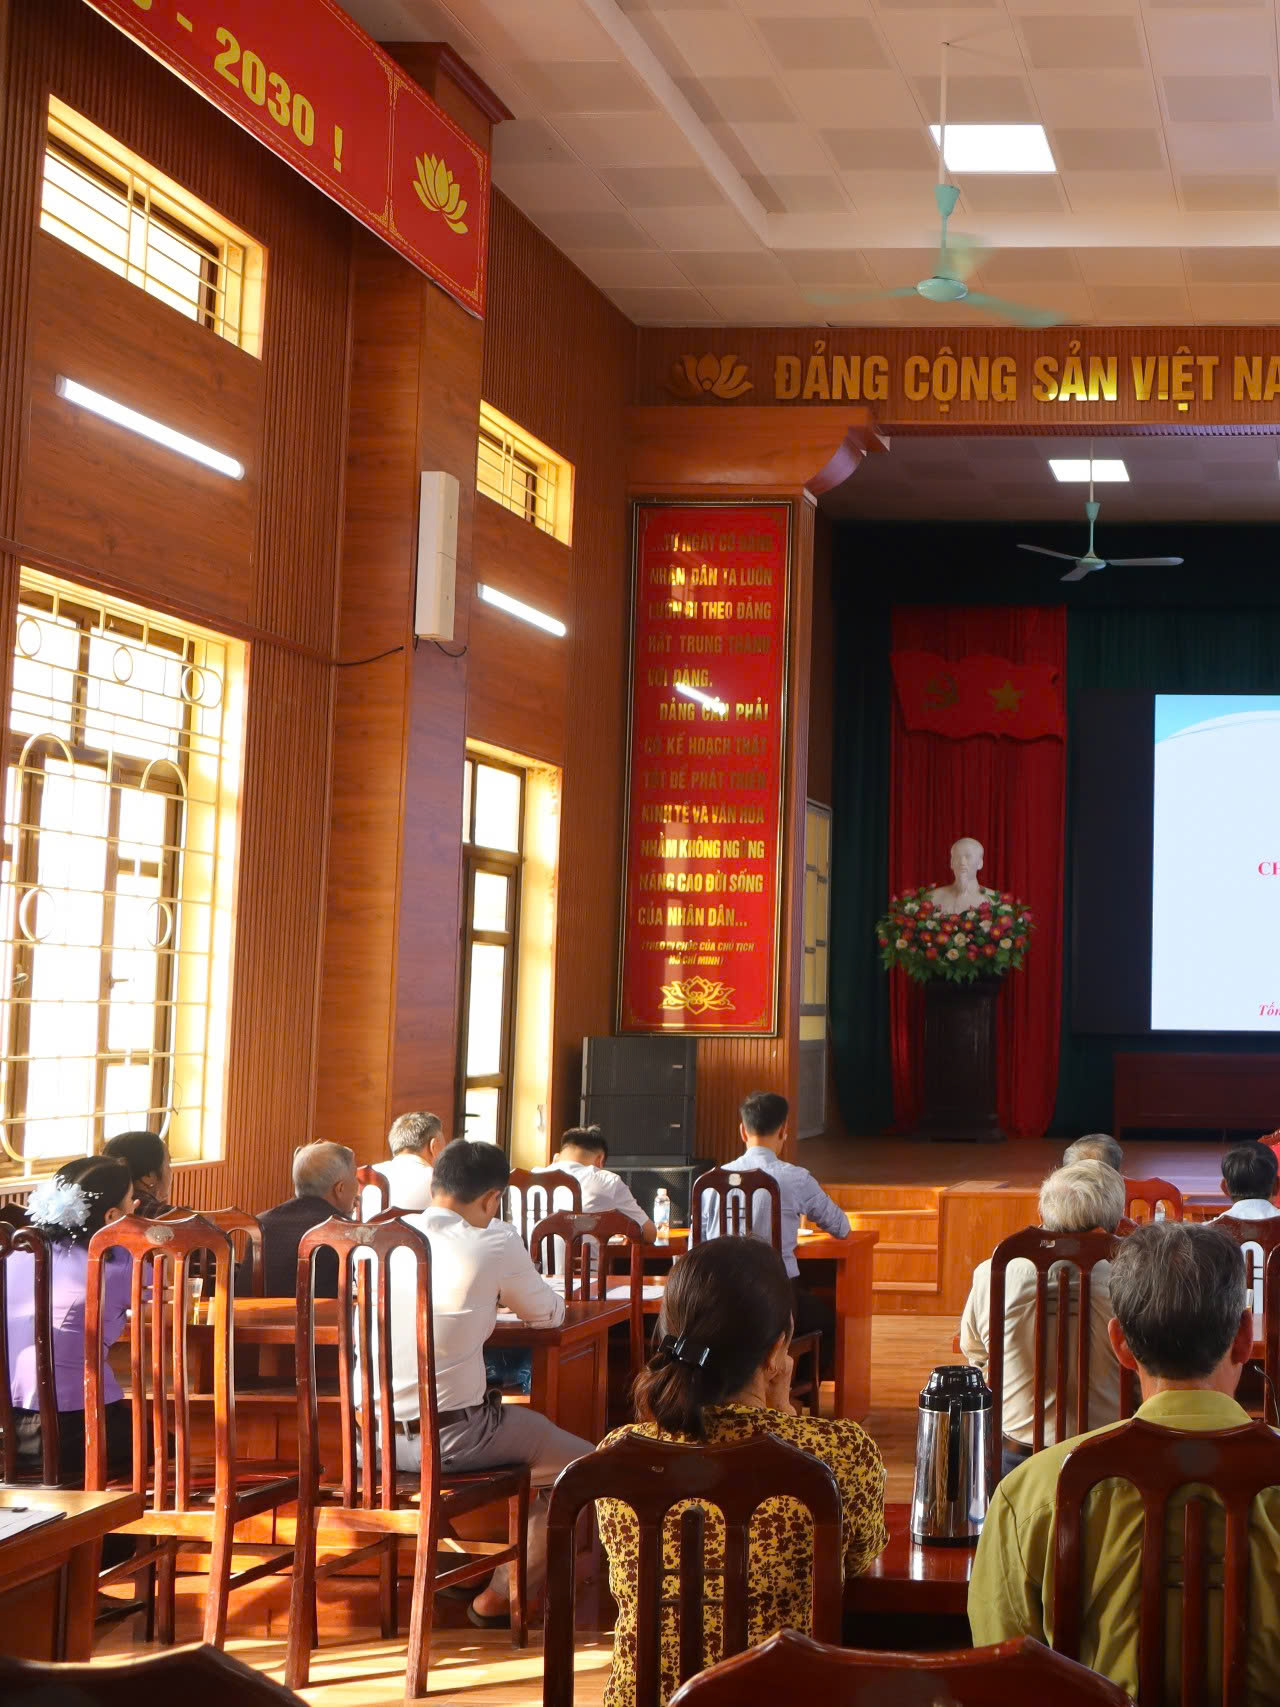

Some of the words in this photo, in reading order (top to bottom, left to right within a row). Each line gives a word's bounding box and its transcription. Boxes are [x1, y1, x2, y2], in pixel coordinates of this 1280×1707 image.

[214, 27, 314, 146] 2030
[776, 340, 889, 399] ĐẢNG
[903, 346, 1017, 412] CỘNG
[1032, 340, 1118, 401] SẢN
[1131, 346, 1220, 411] VIỆT
[722, 568, 737, 586] TA
[701, 601, 733, 620] THEO
[735, 594, 772, 620] ĐẢNG
[679, 634, 723, 655] TRUNG
[659, 697, 695, 720] ĐẢNG
[735, 697, 769, 720] PHẢI
[688, 736, 731, 759] HOẠCH
[679, 835, 721, 858] KHÔNG
[677, 872, 703, 892] CAO
[729, 867, 764, 893] SỐNG
[666, 903, 705, 926] NHÂN
